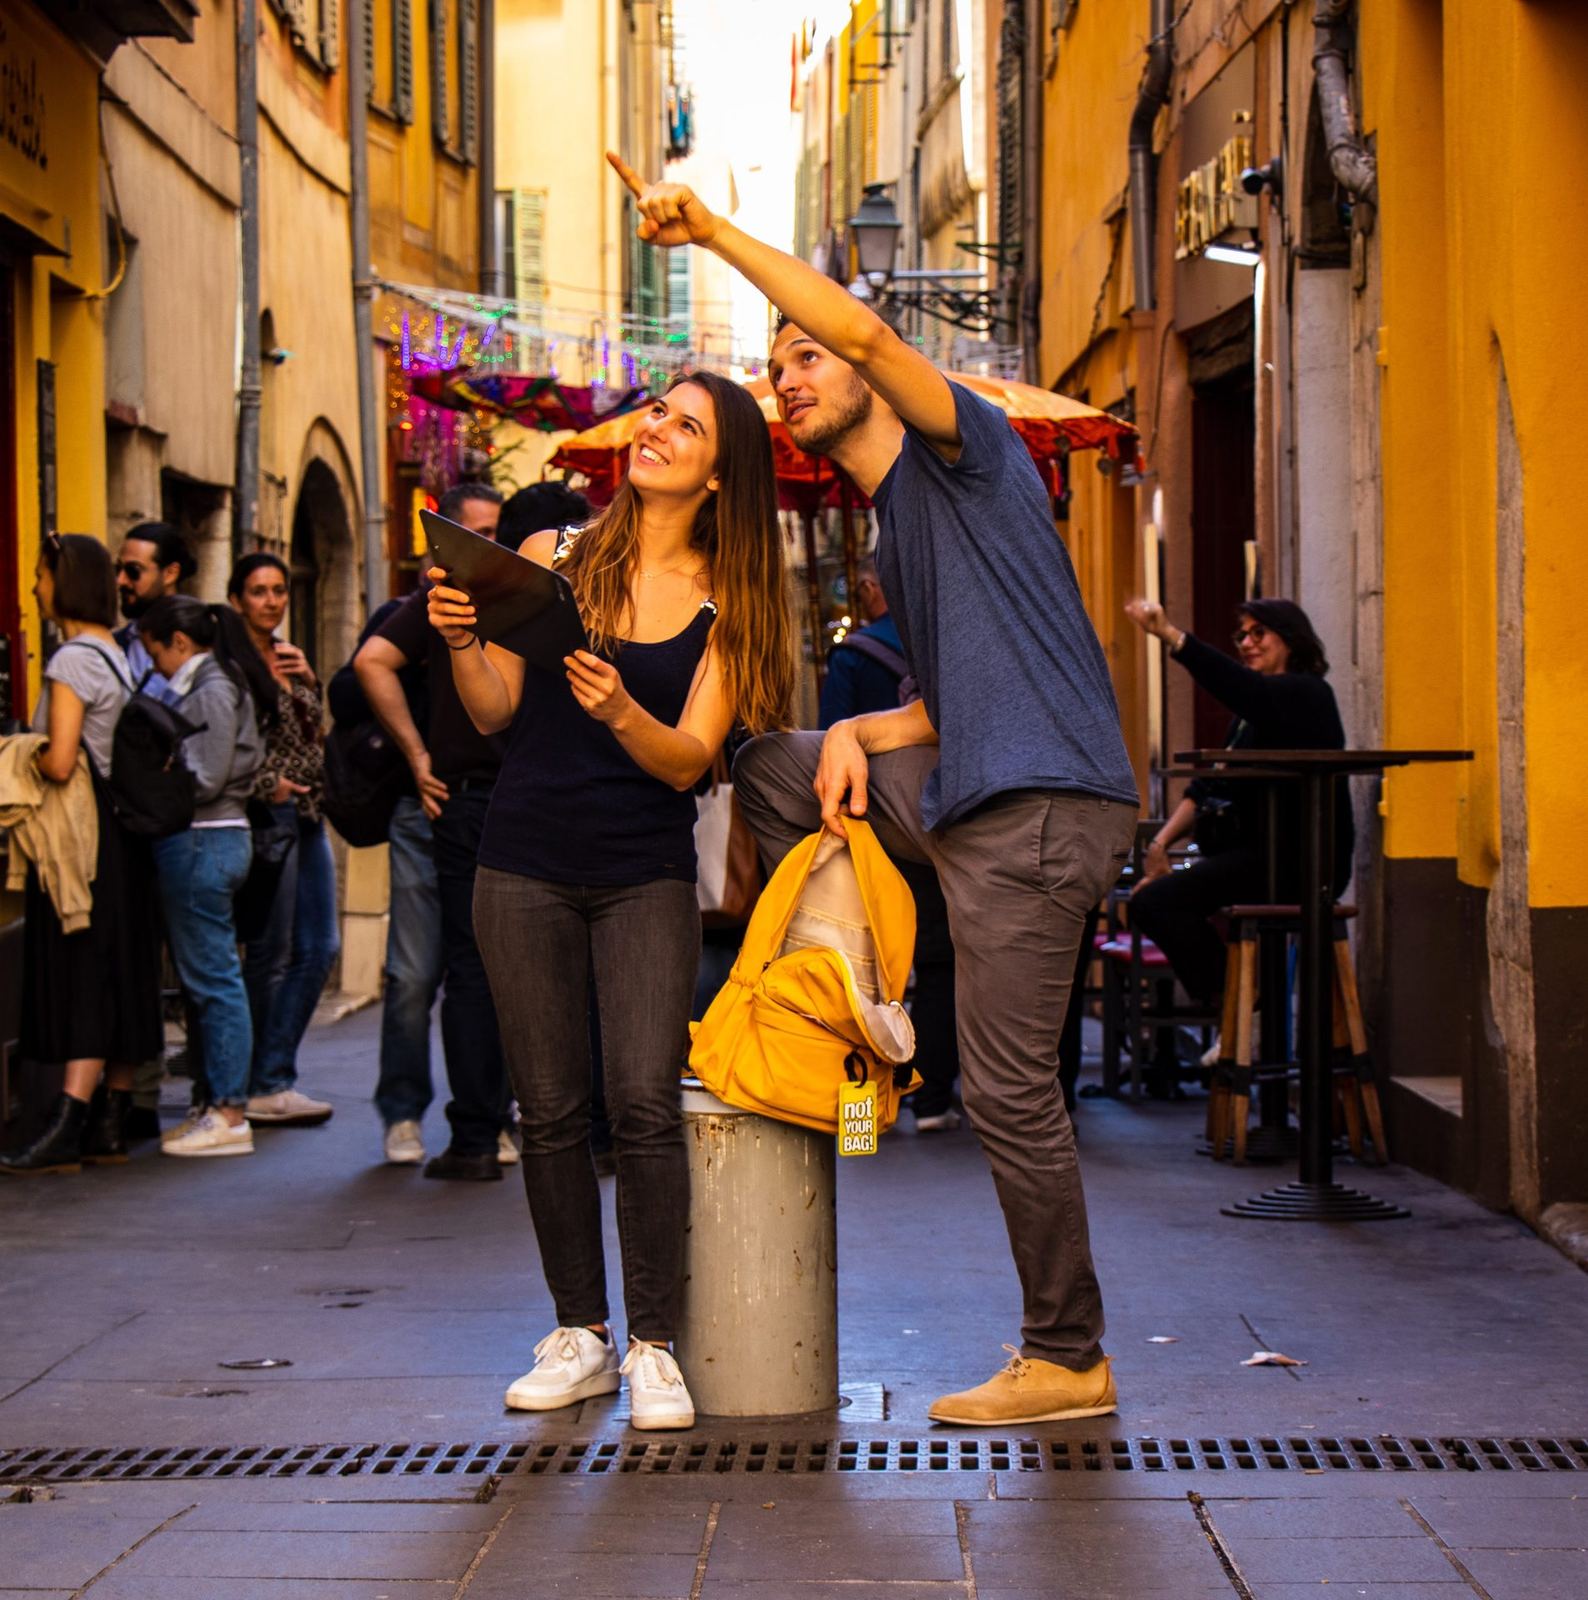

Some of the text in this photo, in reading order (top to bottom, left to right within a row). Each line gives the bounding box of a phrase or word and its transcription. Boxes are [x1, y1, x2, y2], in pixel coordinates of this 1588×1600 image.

[844, 1096, 873, 1119] not
[845, 1120, 873, 1134] YOUR
[844, 1134, 873, 1152] BAG!
